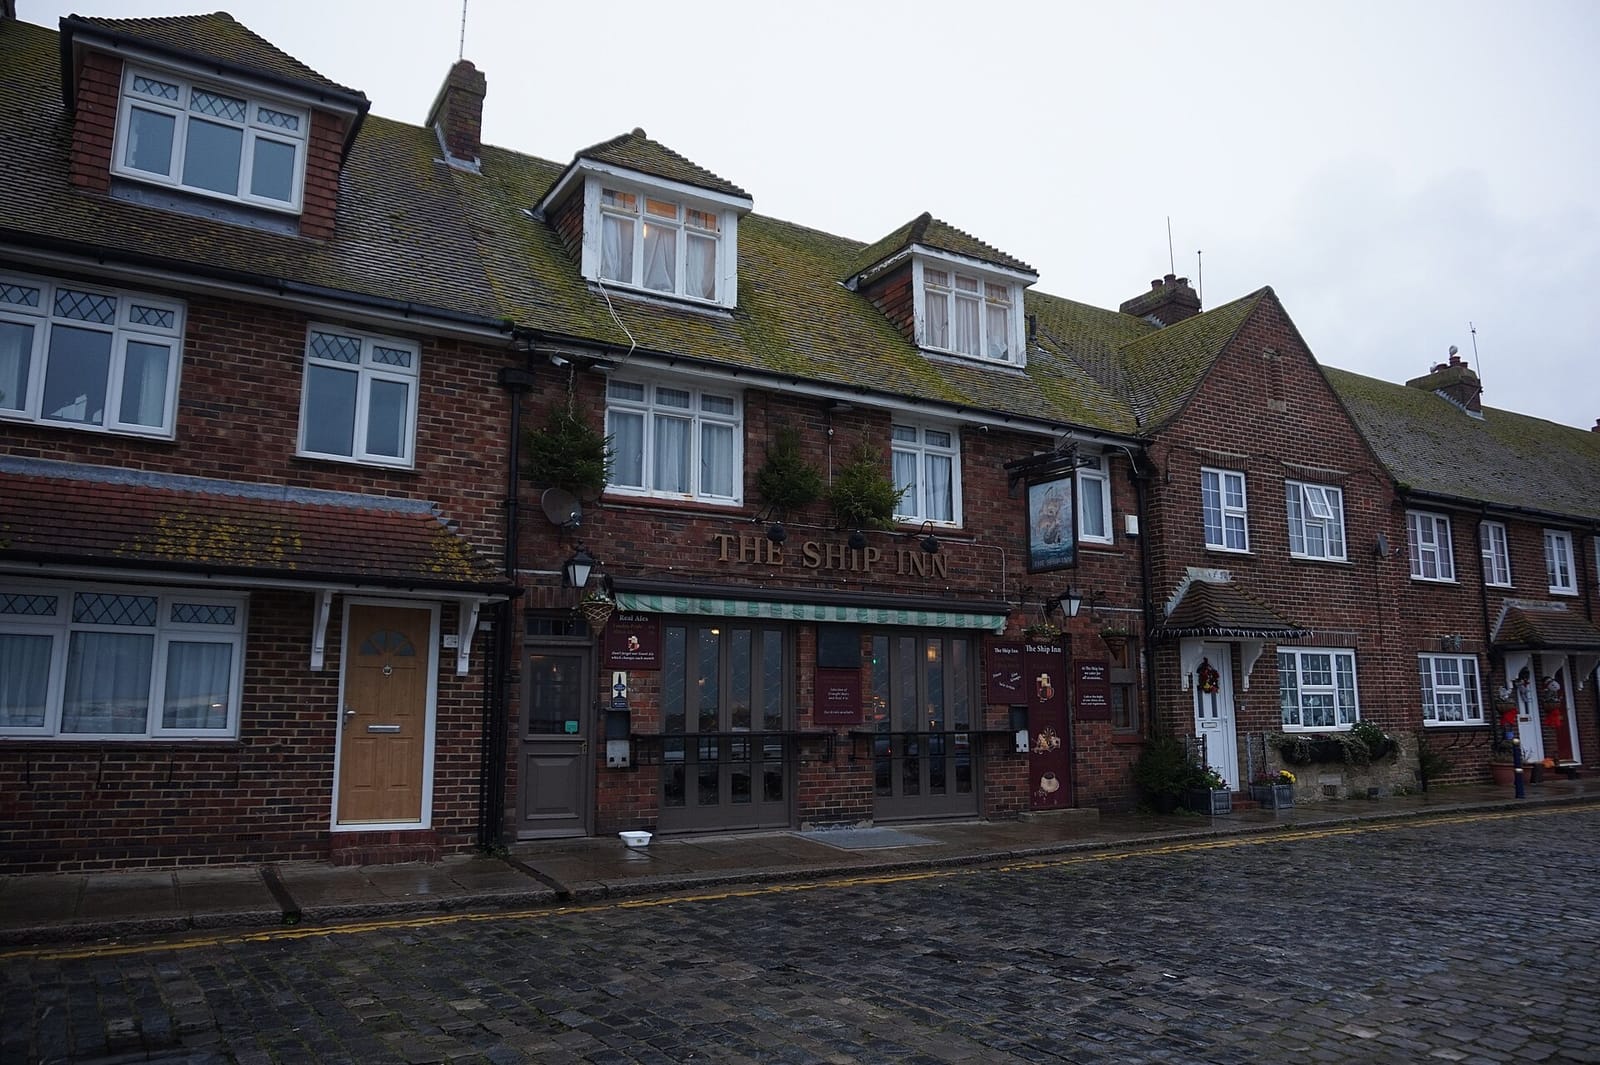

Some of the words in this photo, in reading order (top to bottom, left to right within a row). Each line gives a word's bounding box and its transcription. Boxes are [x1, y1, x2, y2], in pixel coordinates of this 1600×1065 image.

[713, 533, 784, 566] THE
[802, 540, 881, 573] SHIP
[896, 550, 949, 579] INN
[1025, 644, 1036, 652] The
[1037, 645, 1050, 654] Ship
